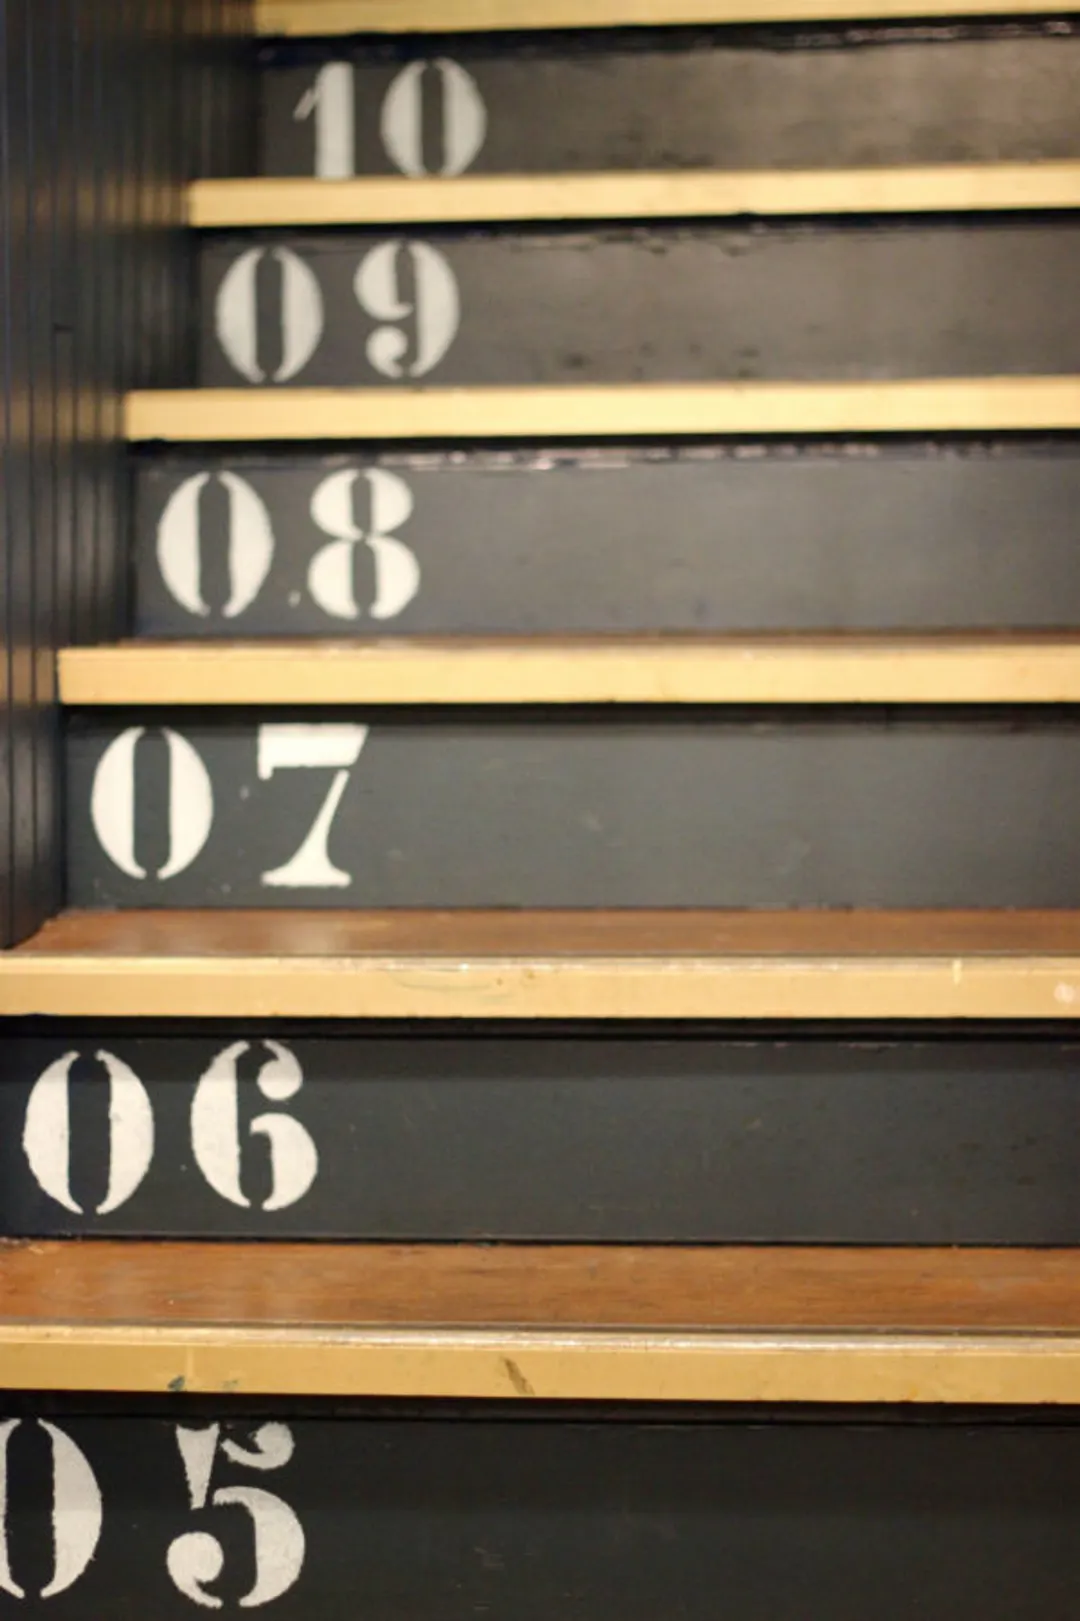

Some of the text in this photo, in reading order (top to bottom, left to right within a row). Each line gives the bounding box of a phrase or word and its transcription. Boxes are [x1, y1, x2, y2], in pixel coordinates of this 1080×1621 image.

[295, 59, 487, 181] 10
[214, 240, 461, 383] 09
[156, 468, 423, 619] 08
[90, 724, 370, 889] 07
[22, 1039, 319, 1215] 06
[0, 1418, 306, 1608] 05
